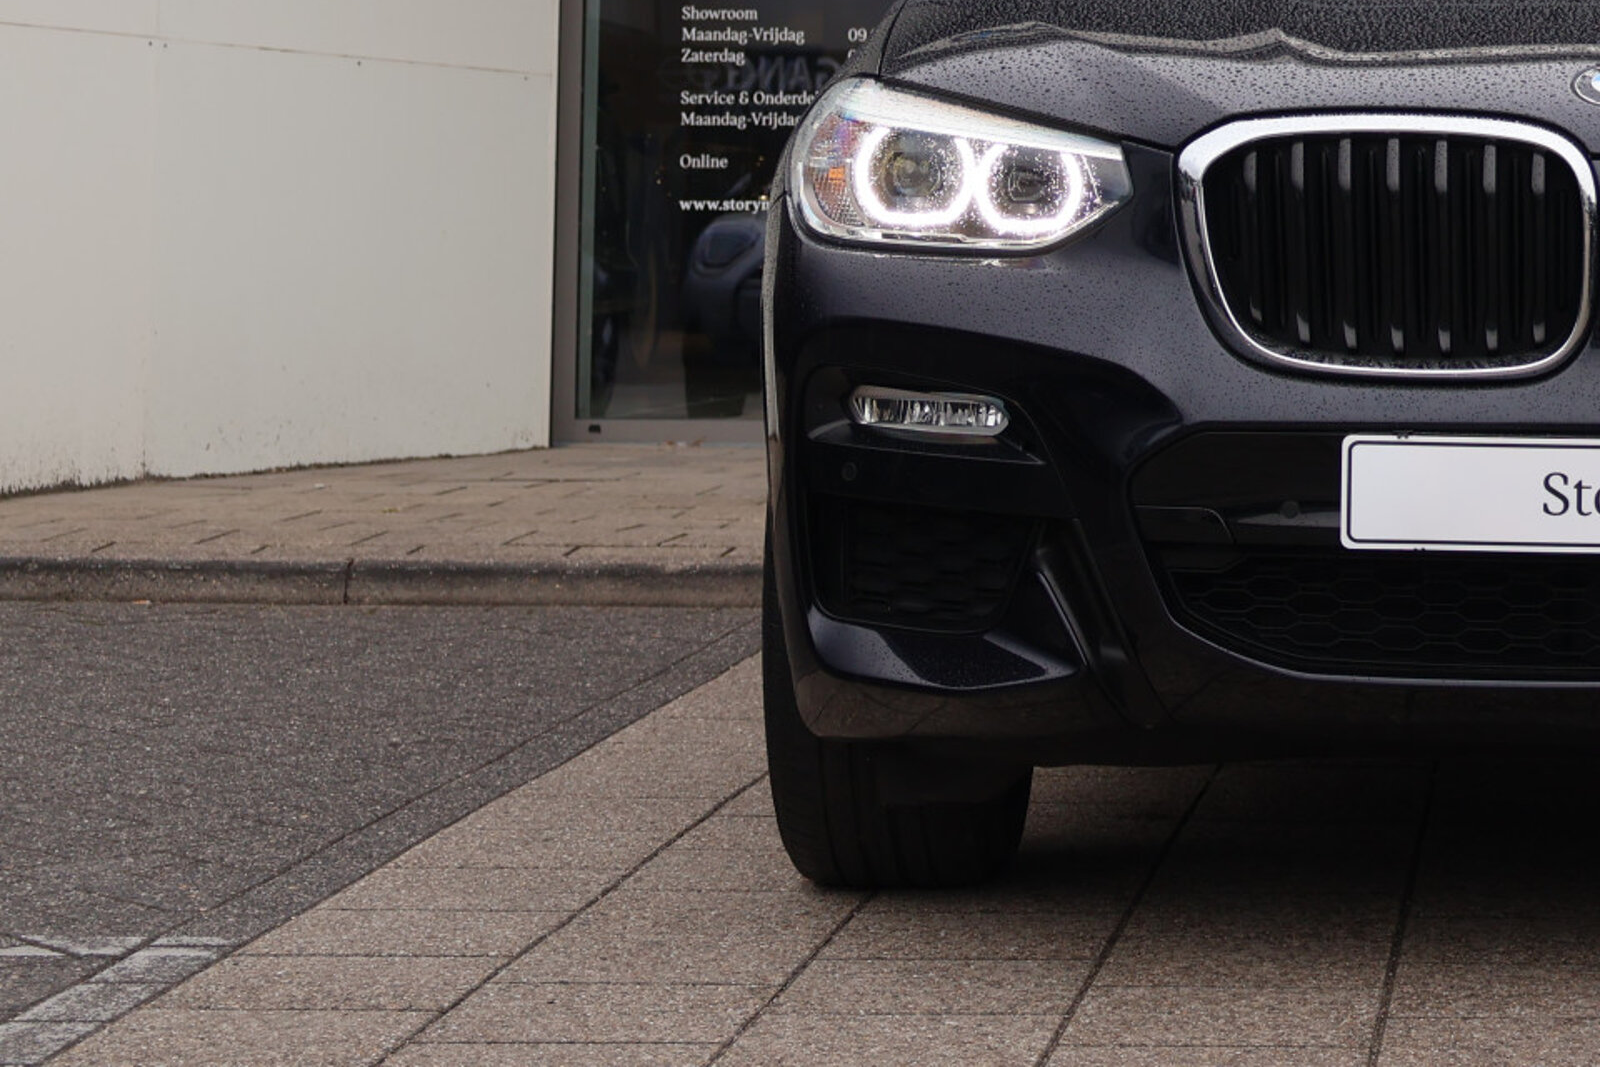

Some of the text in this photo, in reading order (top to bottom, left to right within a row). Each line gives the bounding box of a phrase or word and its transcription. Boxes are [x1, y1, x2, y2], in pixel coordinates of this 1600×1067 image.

[681, 6, 758, 21] Showroom
[681, 28, 805, 45] Maandag-Vrijdag
[681, 49, 745, 66] Zaterdag
[680, 90, 815, 105] Service & Onderde
[679, 154, 728, 169] Online
